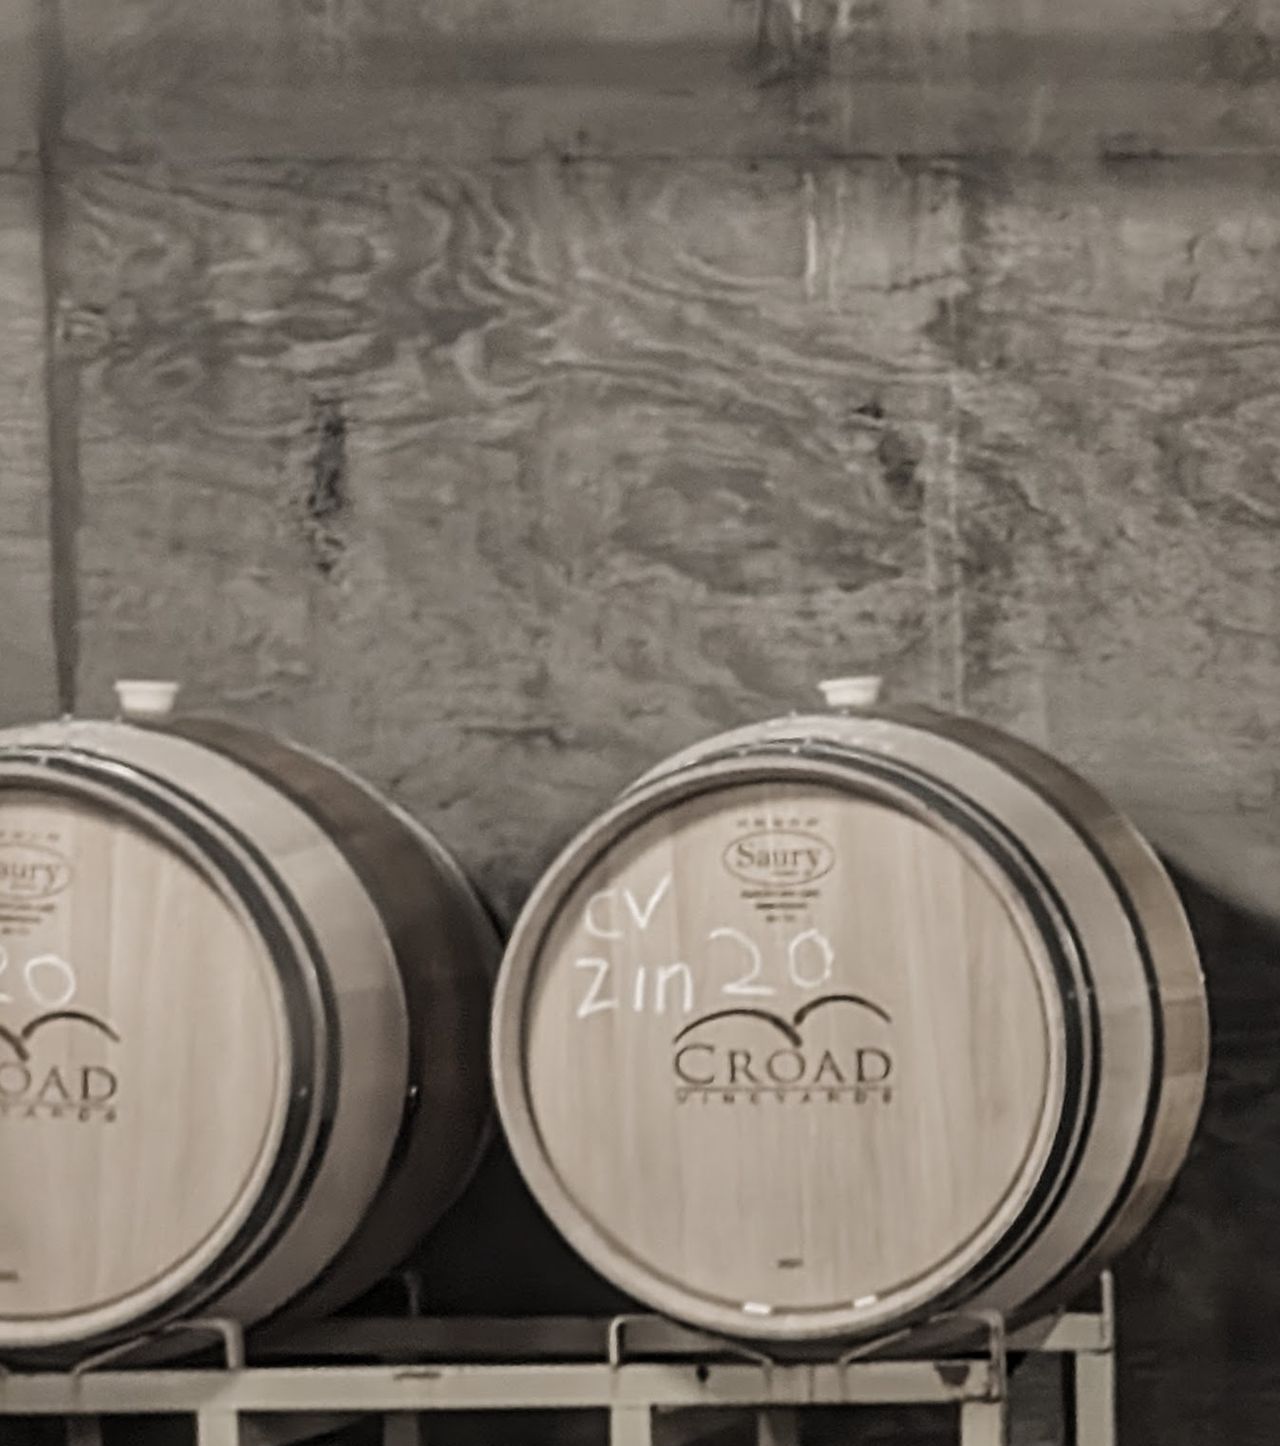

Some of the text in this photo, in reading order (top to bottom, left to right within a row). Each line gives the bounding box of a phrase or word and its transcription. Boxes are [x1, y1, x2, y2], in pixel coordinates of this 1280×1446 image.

[736, 842, 820, 878] Saury
[708, 928, 835, 997] 20
[674, 1043, 892, 1085] CROAD
